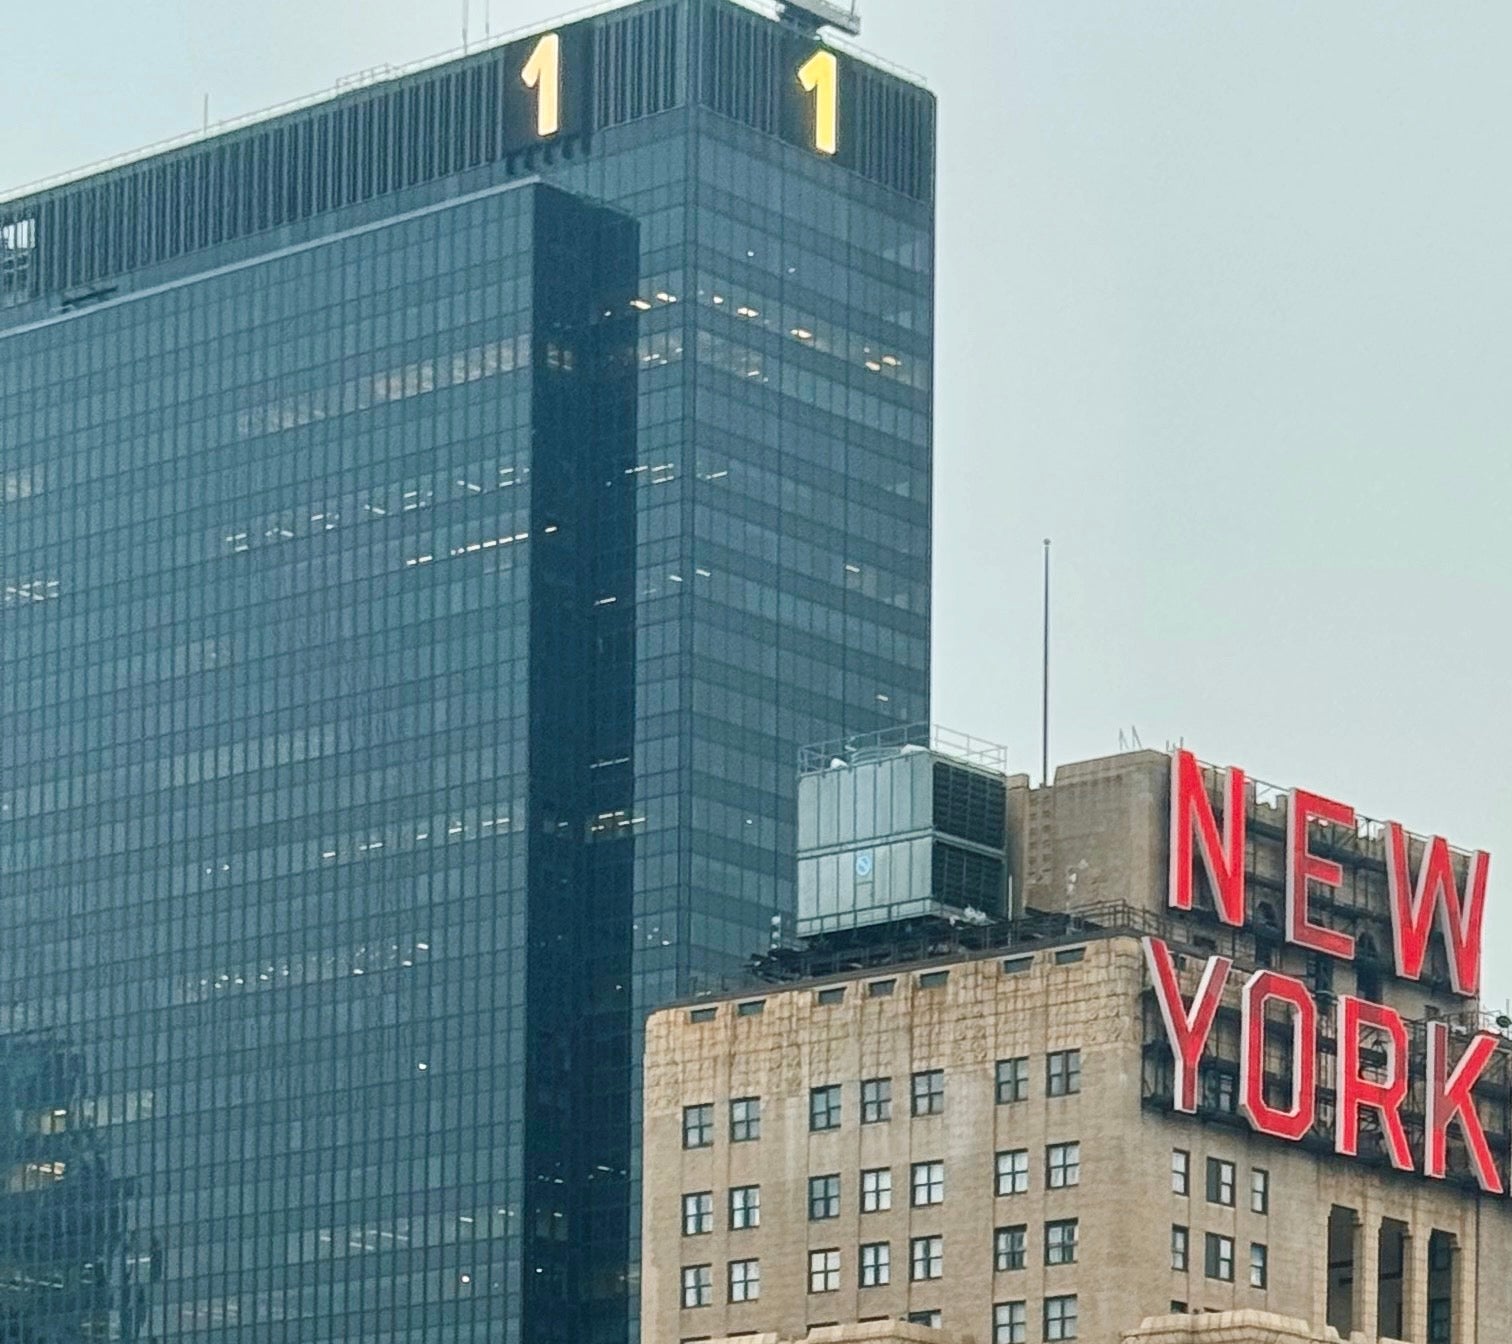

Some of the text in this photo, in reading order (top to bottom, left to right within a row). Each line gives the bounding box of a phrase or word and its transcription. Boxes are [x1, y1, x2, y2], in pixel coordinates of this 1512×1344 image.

[521, 33, 560, 137] 1
[797, 50, 838, 154] 1
[1168, 748, 1491, 997] NEW
